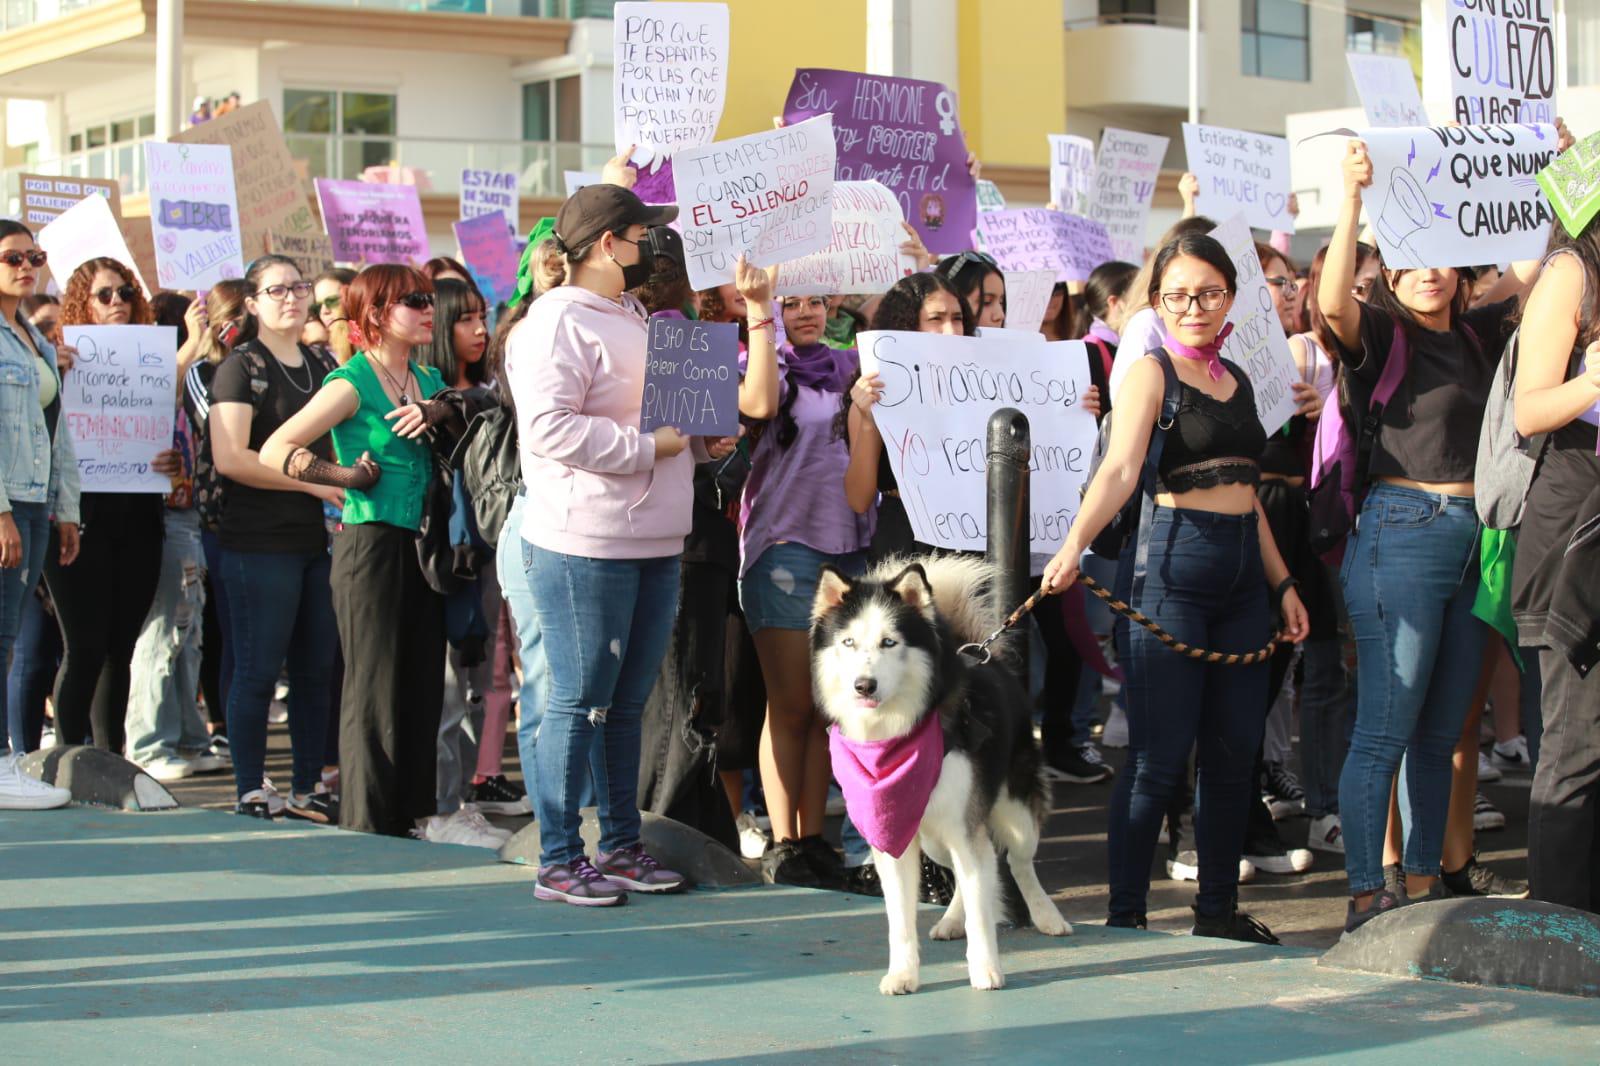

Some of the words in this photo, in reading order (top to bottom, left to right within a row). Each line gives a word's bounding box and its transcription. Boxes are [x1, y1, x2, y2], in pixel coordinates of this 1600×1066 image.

[625, 15, 664, 44] POR
[670, 22, 709, 44] QUE
[620, 42, 644, 62] TE
[645, 45, 717, 63] ESPANTAS
[1452, 14, 1554, 99] CULAZO
[621, 61, 653, 82] POR
[660, 66, 684, 84] LAS
[621, 82, 680, 104] LUCHAN
[686, 86, 695, 104] Y
[698, 88, 717, 104] NO
[795, 72, 838, 112] Sin
[852, 77, 926, 125] HERMIONE
[620, 105, 662, 127] POR
[663, 108, 687, 124] LAS
[691, 107, 714, 124] QUE
[688, 131, 808, 177] TEMPESTAD
[866, 125, 938, 162] POTTER
[1198, 127, 1249, 153] Entiende
[1507, 149, 1562, 178] NUNC
[27, 181, 50, 190] POR
[57, 184, 78, 194] LAS
[462, 168, 516, 190] ESTAR
[696, 171, 767, 203] CUANDO
[161, 199, 231, 230] LIBRE
[692, 203, 723, 227] EL
[730, 179, 809, 219] SILENCIO
[683, 228, 713, 252] SOY
[804, 190, 830, 214] QUE
[173, 233, 239, 276] VALIENTE
[689, 250, 727, 274] TU
[653, 319, 684, 350] Esto
[682, 358, 729, 381] Como
[872, 335, 923, 408] Si
[927, 360, 1026, 407] mañana
[81, 386, 93, 405] la
[101, 389, 153, 413] palabra
[654, 385, 719, 425] NIÑA
[66, 412, 171, 441] FEMINICIDIO
